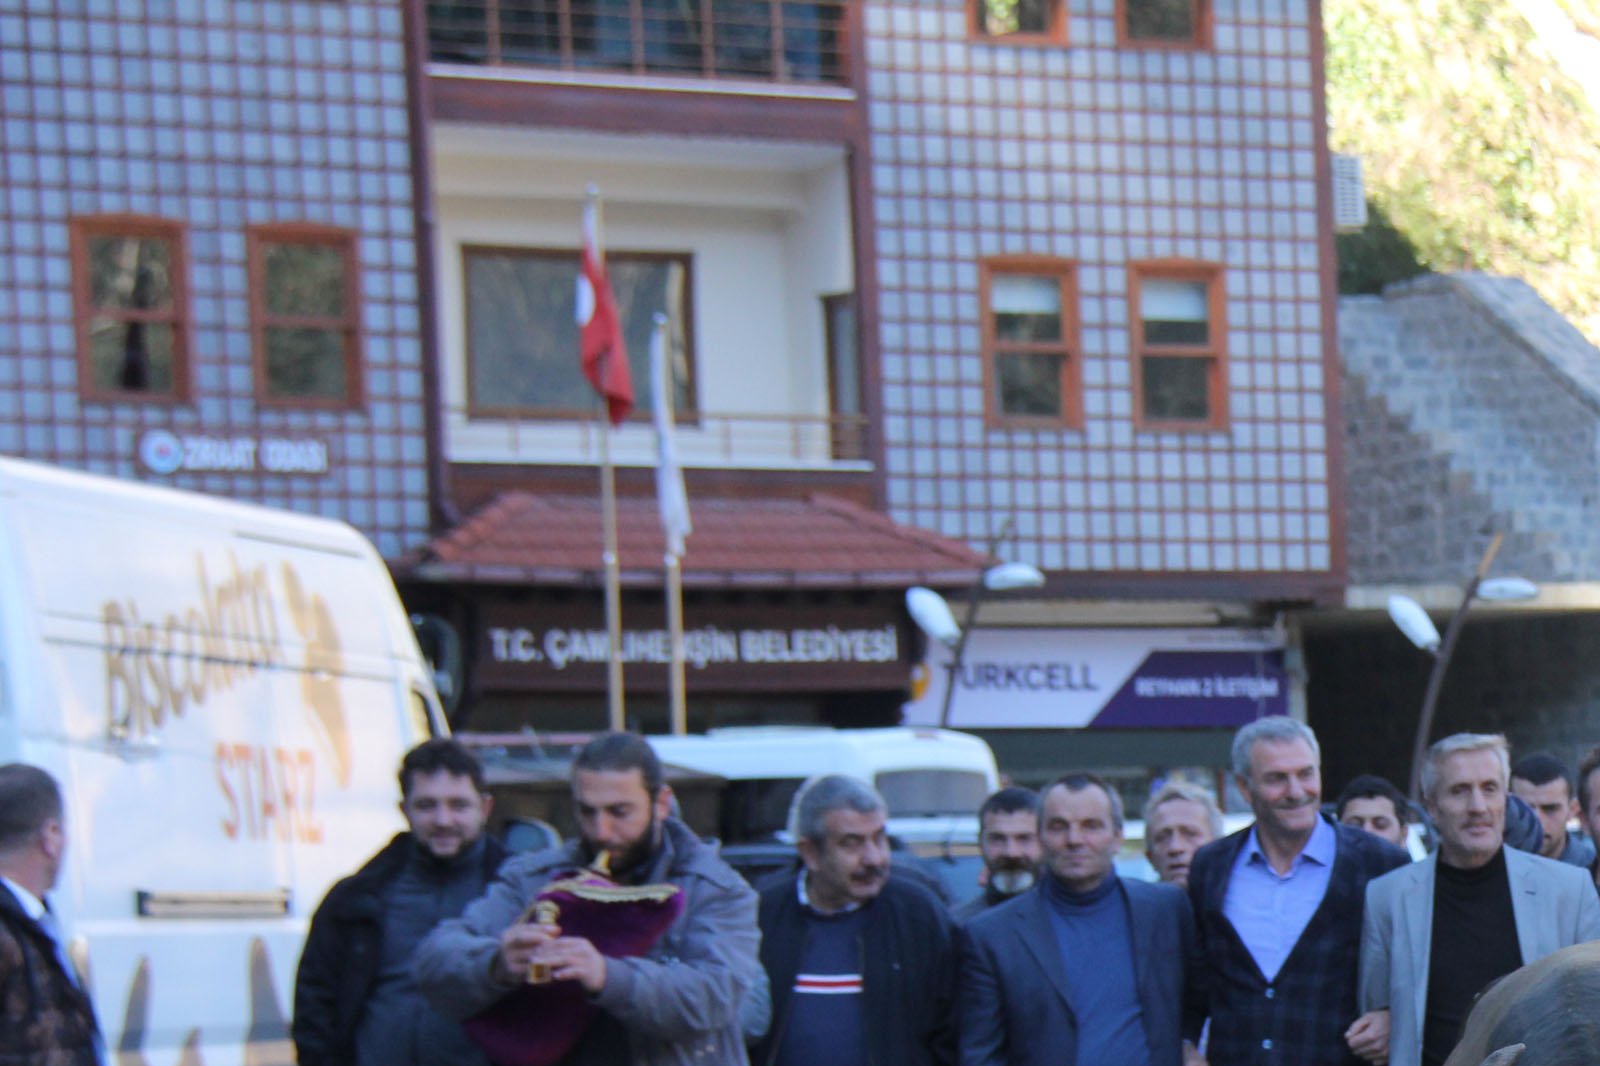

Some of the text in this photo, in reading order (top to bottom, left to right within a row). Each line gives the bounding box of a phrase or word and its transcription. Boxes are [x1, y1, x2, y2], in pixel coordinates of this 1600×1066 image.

[488, 627, 544, 662] T.C.
[740, 624, 898, 662] BELEDİYESİ
[215, 741, 325, 844] STARZ
